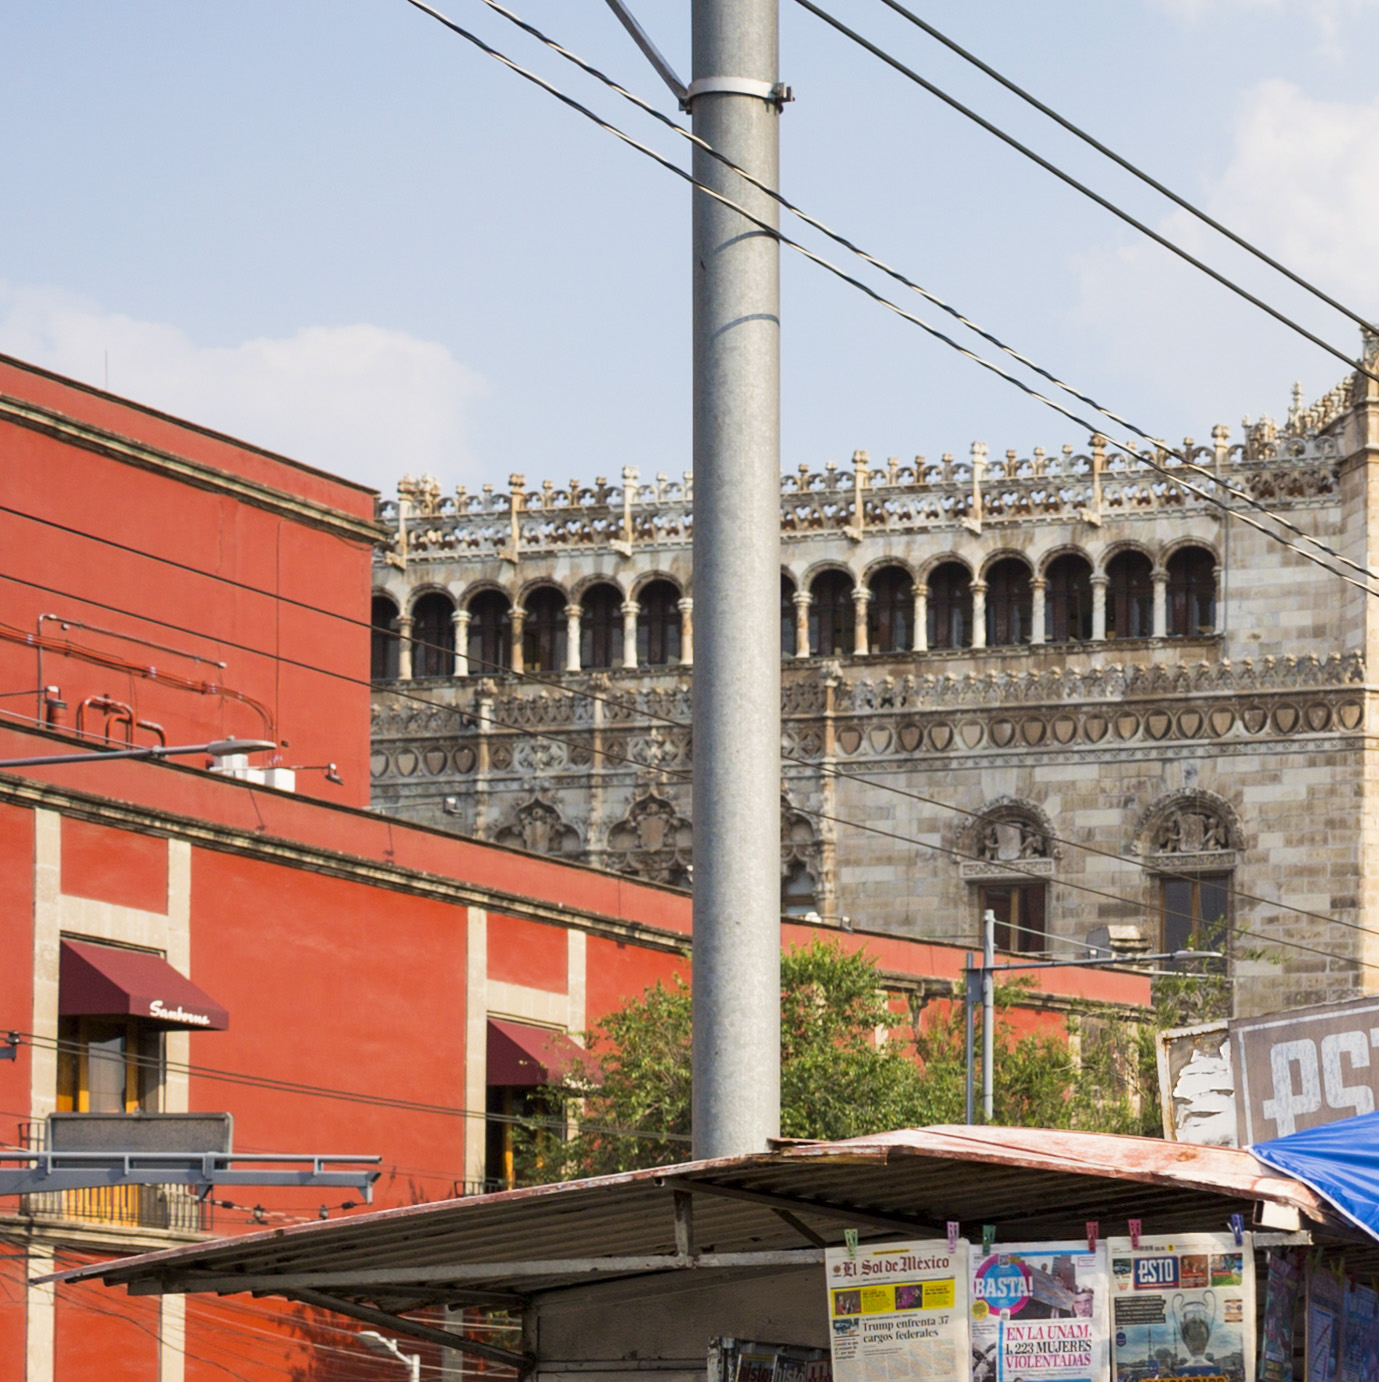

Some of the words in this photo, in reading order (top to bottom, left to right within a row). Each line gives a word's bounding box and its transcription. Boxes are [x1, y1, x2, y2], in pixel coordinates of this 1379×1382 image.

[843, 1262, 857, 1277] El
[861, 1260, 883, 1276] Sol
[885, 1259, 898, 1272] de
[899, 1255, 950, 1272] México
[974, 1276, 1034, 1297] BASTA!
[862, 1321, 894, 1334] Trump
[896, 1318, 936, 1329] enfrenta
[938, 1315, 949, 1325] 37
[863, 1332, 893, 1343] cargos
[895, 1329, 939, 1340] federales
[1006, 1327, 1025, 1340] EN
[1028, 1326, 1043, 1340] LA
[1036, 1340, 1092, 1353] MUJERES
[1006, 1353, 1091, 1368] VIOLENTADAS
